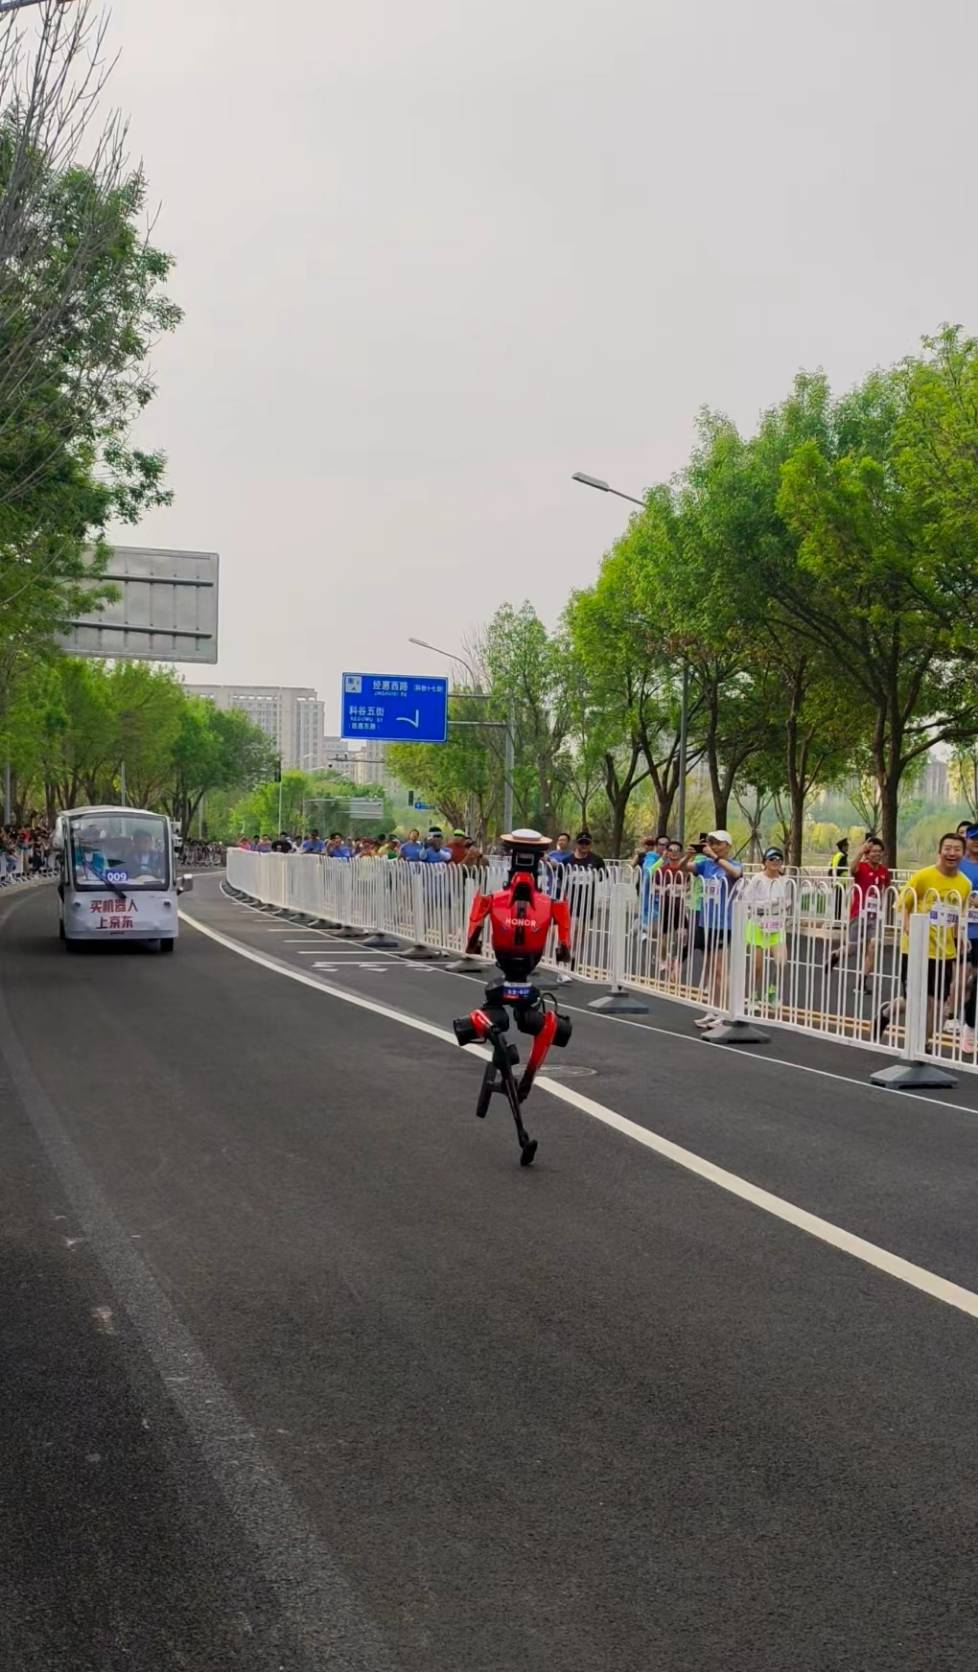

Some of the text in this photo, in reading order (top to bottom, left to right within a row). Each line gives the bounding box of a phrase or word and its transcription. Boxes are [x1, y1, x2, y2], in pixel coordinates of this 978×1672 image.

[107, 872, 127, 881] 009
[90, 899, 138, 913] 买机器人
[96, 916, 133, 929] 上京东
[505, 918, 537, 927] HONOR
